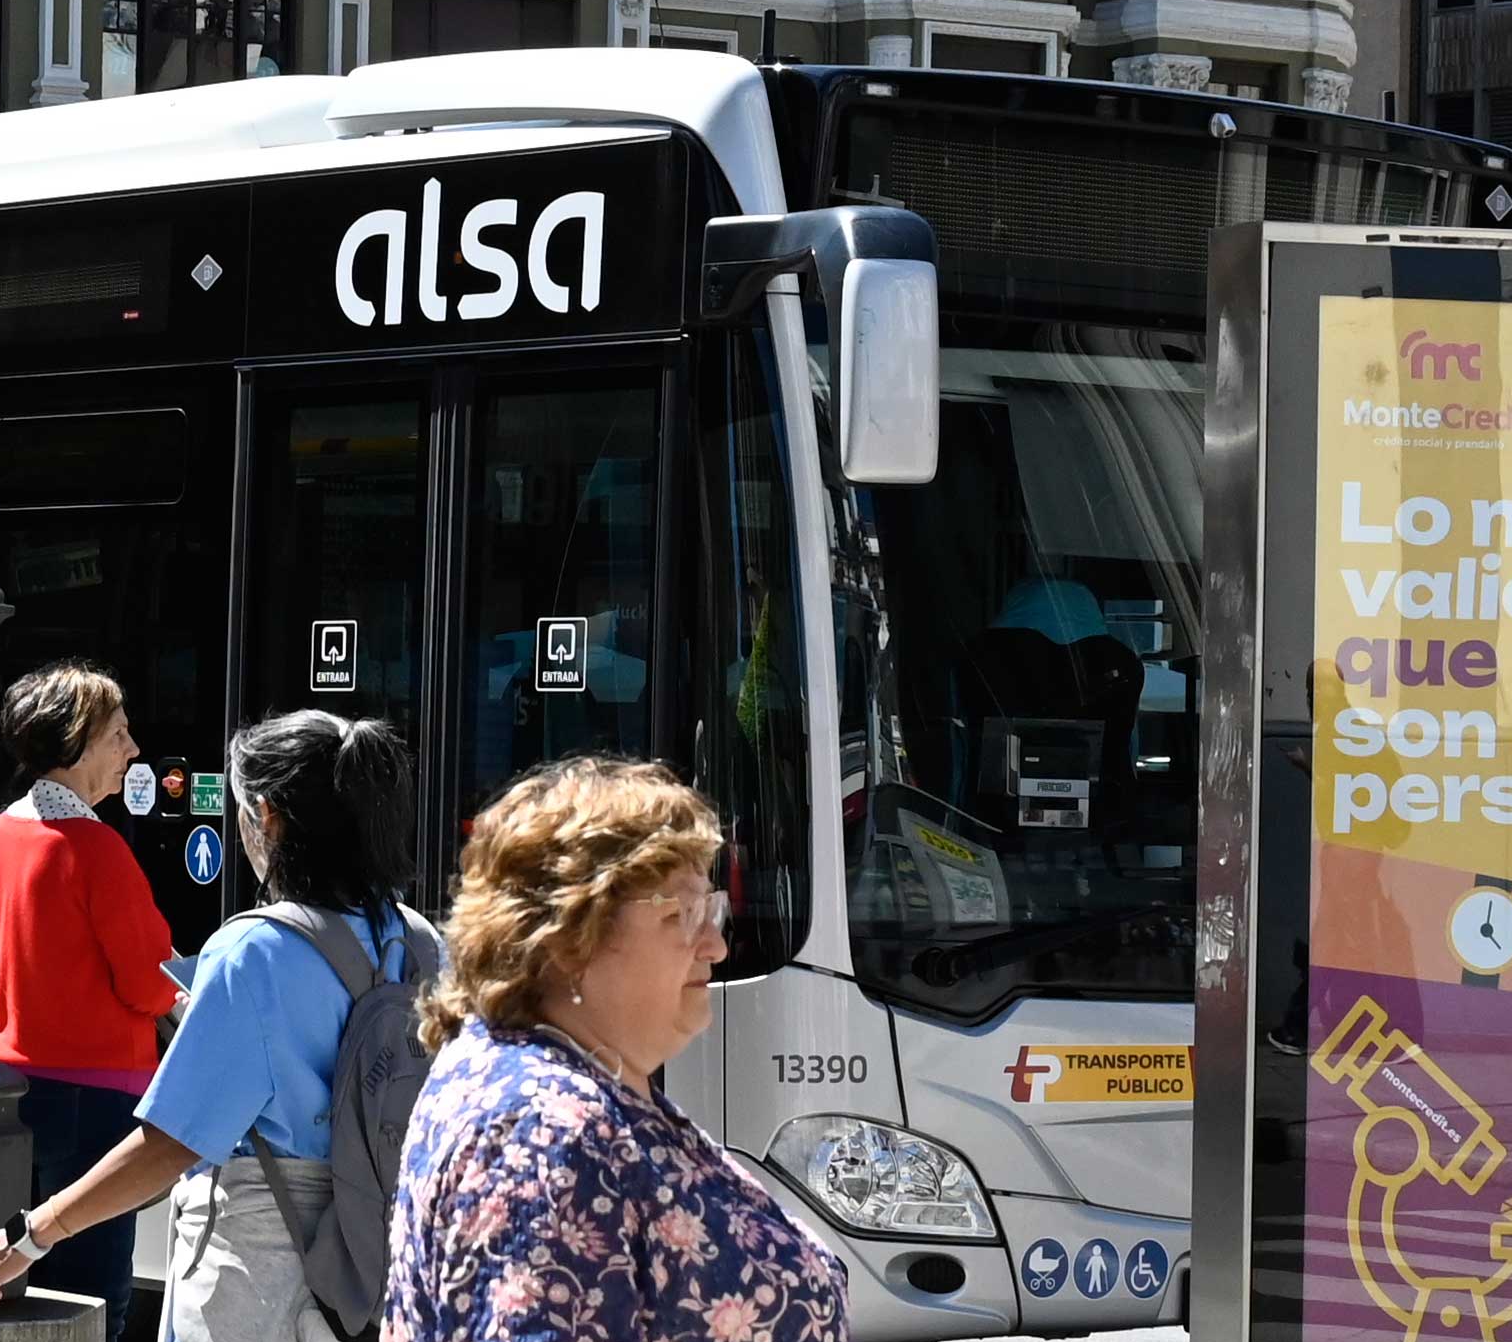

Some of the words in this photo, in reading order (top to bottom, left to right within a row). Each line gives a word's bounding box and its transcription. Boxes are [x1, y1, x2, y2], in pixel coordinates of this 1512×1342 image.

[335, 177, 606, 326] alsa
[1413, 437, 1443, 448] social
[1445, 439, 1451, 450] y
[1455, 439, 1505, 450] prendario
[1340, 480, 1451, 546] Lo
[316, 670, 351, 684] ENTRADA
[542, 670, 580, 684] ENTRADA
[1335, 635, 1498, 698] que
[1332, 704, 1497, 758] son
[771, 1054, 869, 1084] 13390
[1066, 1053, 1186, 1070] TRANSPORTE
[1106, 1074, 1185, 1094] PÚBLICO
[1381, 1066, 1462, 1144] montecredit.es
